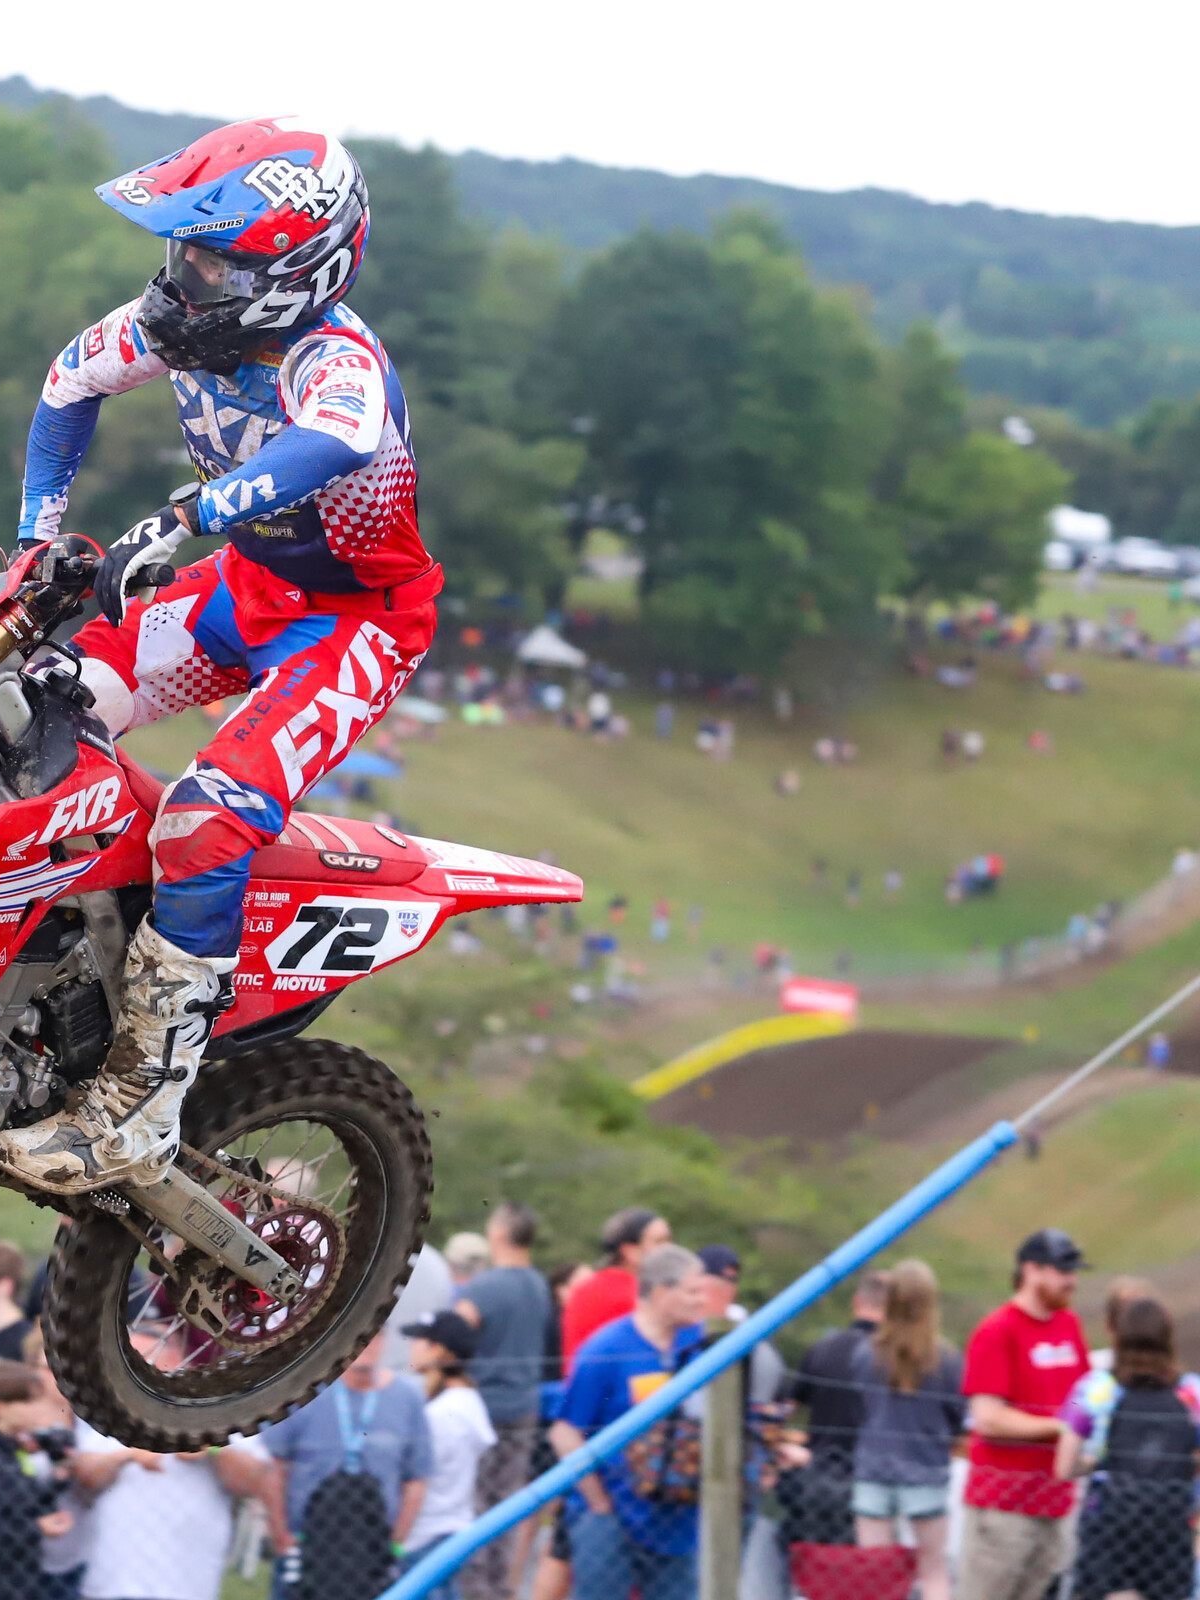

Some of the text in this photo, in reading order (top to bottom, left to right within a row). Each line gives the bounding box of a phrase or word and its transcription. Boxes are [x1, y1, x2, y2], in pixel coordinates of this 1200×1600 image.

[35, 775, 121, 845] FXR
[323, 853, 380, 869] GUTS
[445, 874, 499, 891] PIRELLI
[255, 892, 290, 901] RED RIDER
[249, 920, 274, 933] LAB
[277, 905, 389, 971] 72
[272, 976, 326, 992] MOTUL
